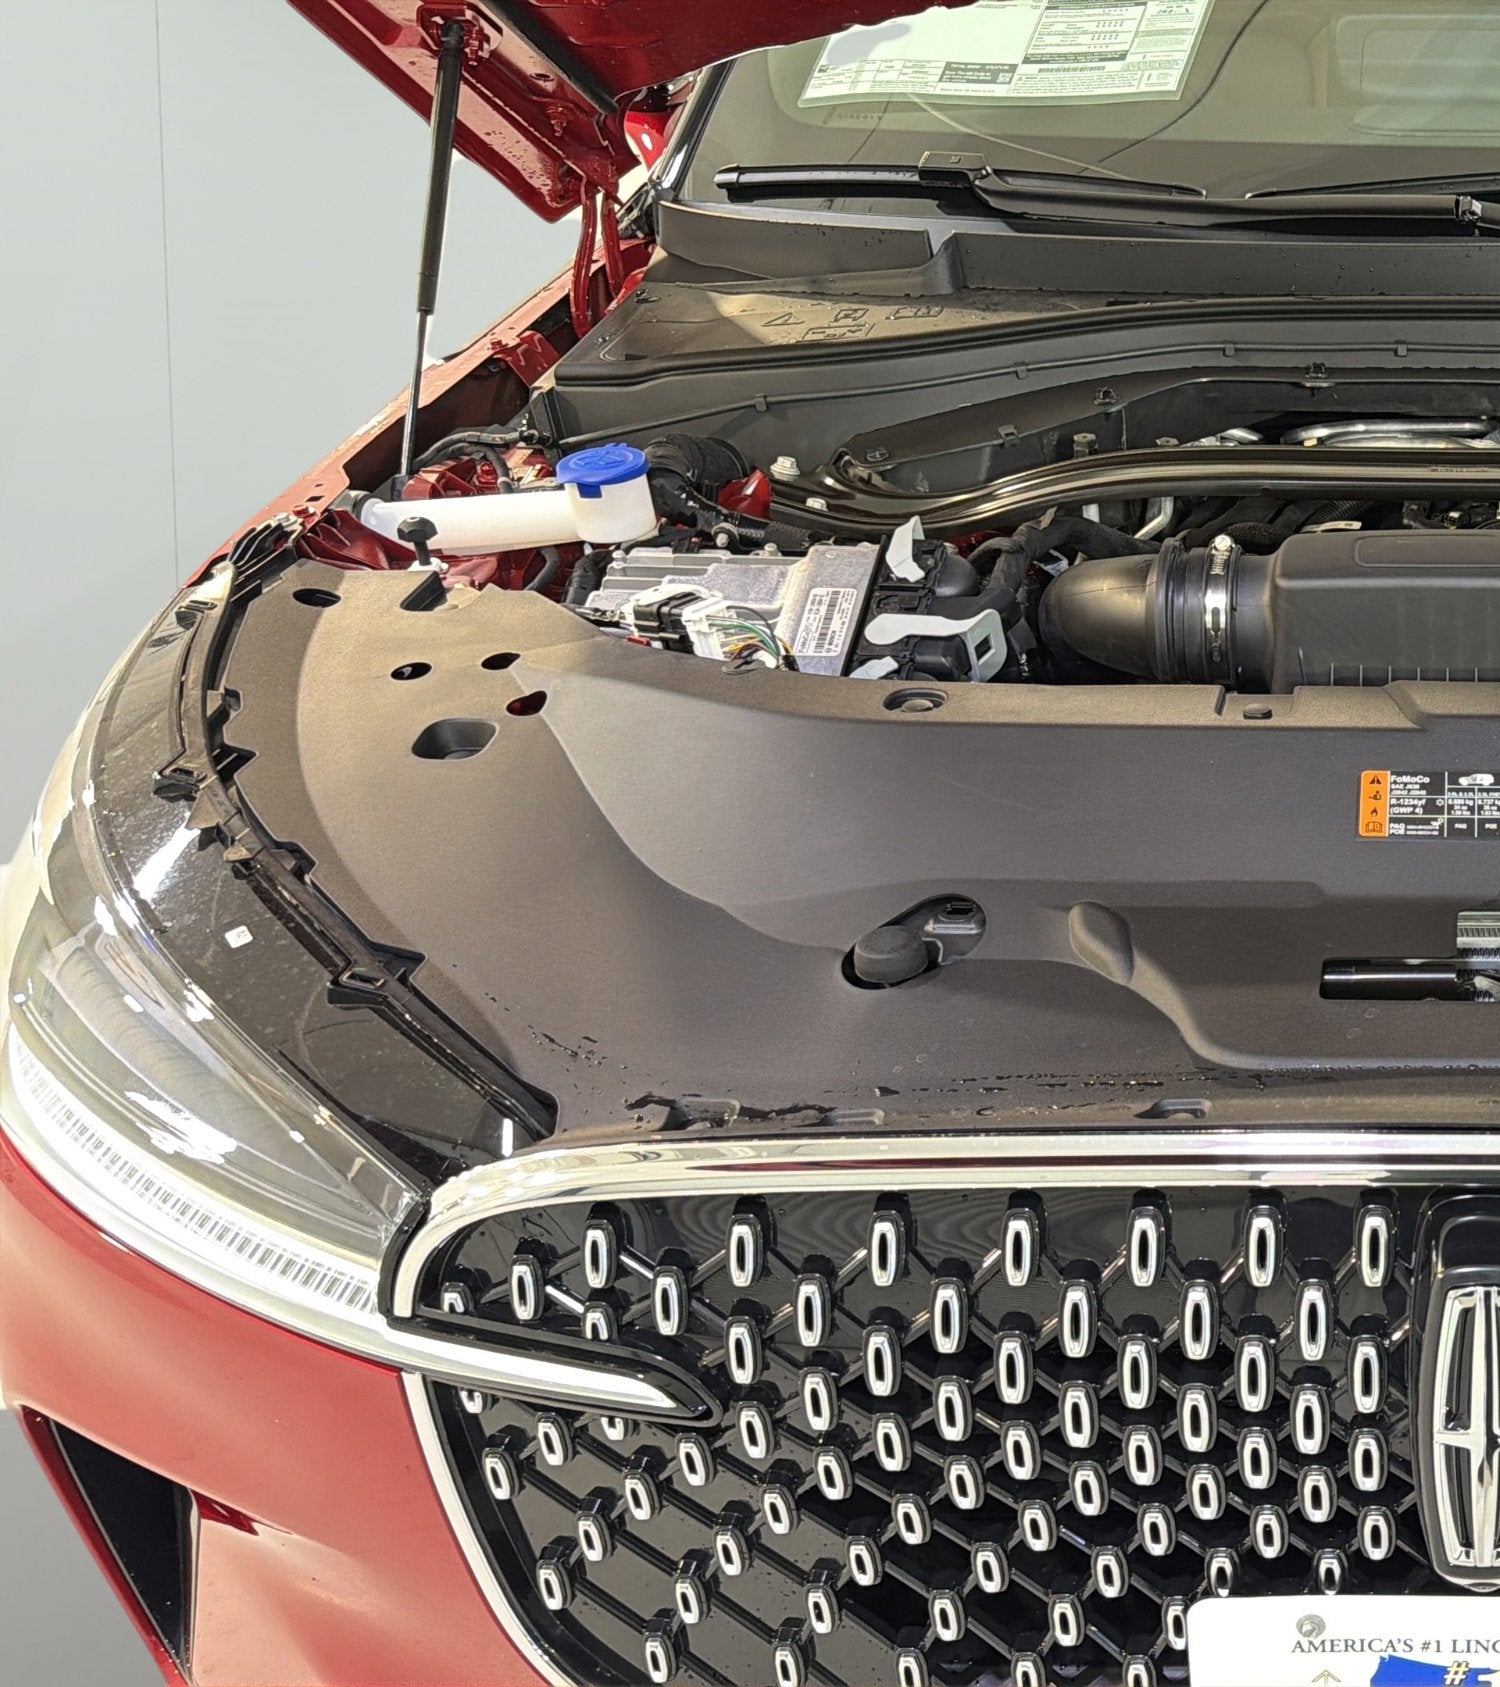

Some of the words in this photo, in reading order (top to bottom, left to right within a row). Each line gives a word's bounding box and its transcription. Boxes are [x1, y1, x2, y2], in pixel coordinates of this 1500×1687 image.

[1390, 775, 1430, 784] FoMoCo
[1390, 798, 1426, 806] R-1234yf
[1390, 806, 1414, 815] (GWP
[1291, 1638, 1415, 1654] AMERICA'S
[1420, 1640, 1442, 1654] #1
